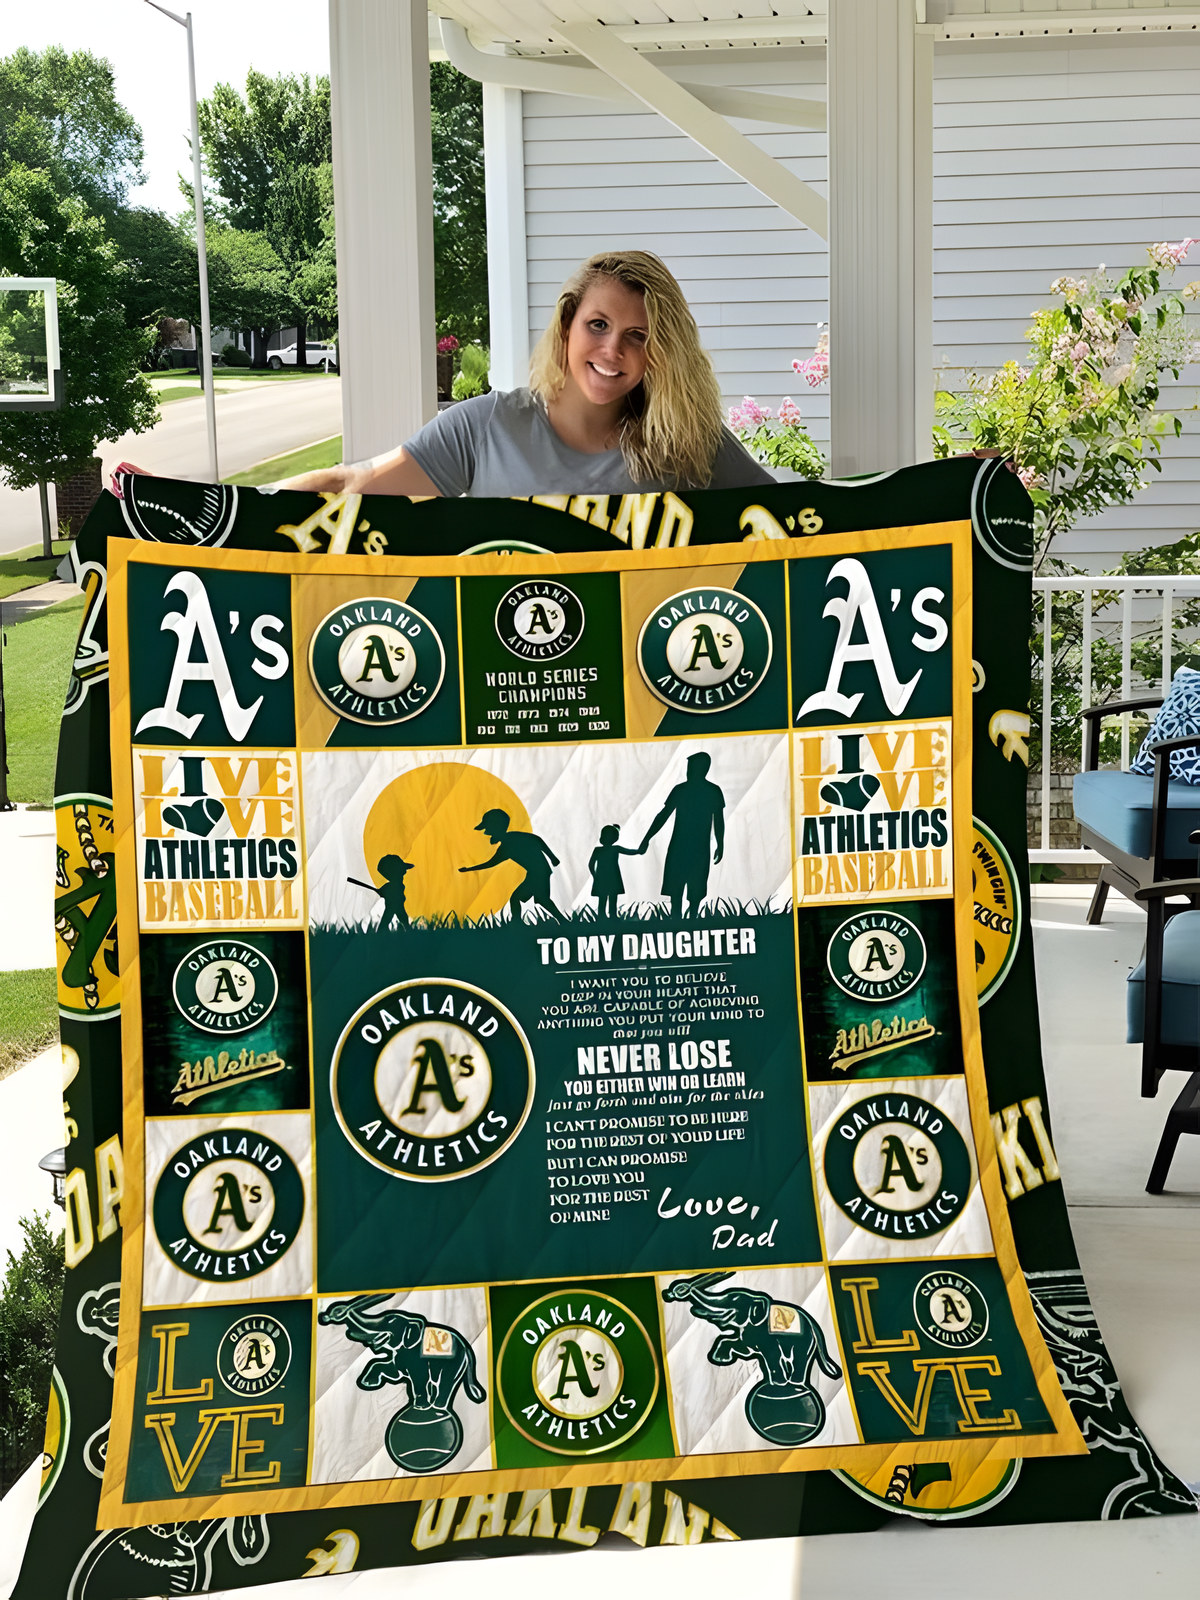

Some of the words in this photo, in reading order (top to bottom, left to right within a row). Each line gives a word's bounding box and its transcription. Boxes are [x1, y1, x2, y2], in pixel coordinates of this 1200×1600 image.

[508, 585, 569, 606] OAKLAND
[658, 596, 750, 629] OAKLAND
[329, 606, 421, 637] OAKLAND
[525, 603, 558, 635] A's
[134, 569, 291, 742] A's
[507, 633, 573, 656] ATHLETICS
[684, 624, 733, 673] A's
[796, 558, 949, 721] A's
[355, 635, 405, 683] A's
[543, 668, 598, 684] SERIES
[328, 682, 427, 716] ATHLETICS
[657, 668, 754, 705] ATHLETICS
[800, 726, 948, 776] LIVE
[139, 754, 293, 797] LIVE
[801, 808, 948, 855] ATHLETICS
[144, 838, 298, 879] ATHLETICS
[803, 849, 948, 896] BASEBALL
[144, 880, 298, 922] BASEBALL
[537, 937, 570, 965] TO
[577, 934, 615, 963] MY
[622, 928, 756, 961] DAUGHTER
[841, 918, 910, 942] OAKLAND
[188, 946, 260, 972] OAKLAND
[861, 937, 898, 972] A's
[208, 967, 247, 1003] A's
[622, 976, 648, 987] YOU
[655, 975, 671, 985] TO
[841, 969, 914, 995] ATHLETICS
[188, 1001, 264, 1028] ATHLETICS
[361, 993, 498, 1045] OAKLAND
[541, 1005, 569, 1016] YOU
[608, 1015, 635, 1027] YOU
[748, 1008, 765, 1019] TO
[577, 1043, 661, 1075] NEVER
[668, 1039, 732, 1070] LOSE
[400, 1037, 475, 1116] A's
[564, 1080, 593, 1096] YOU
[596, 1077, 644, 1094] EITHER
[648, 1075, 677, 1092] WIN
[703, 1071, 745, 1088] LEARN
[359, 1110, 508, 1167] ATHLETICS
[668, 1114, 690, 1126] TO
[715, 1128, 745, 1141] LIFE
[839, 1100, 943, 1140] OAKLAND
[174, 1136, 282, 1179] OAKLAND
[587, 1155, 618, 1168] CAN
[871, 1134, 929, 1197] A's
[548, 1176, 569, 1188] TO
[612, 1171, 645, 1184] YOU
[202, 1172, 262, 1236] A's
[573, 1209, 610, 1223] MINE
[657, 1187, 760, 1220] Love,
[844, 1190, 959, 1234] ATHLETICS
[169, 1229, 286, 1276] ATHLETICS
[712, 1219, 778, 1250] Dad
[522, 1303, 626, 1345] OAKLAND
[840, 1277, 921, 1354] L
[146, 1322, 214, 1406] L
[549, 1340, 606, 1401] A's
[856, 1355, 1023, 1436] VE
[521, 1394, 637, 1440] ATHLETICS
[144, 1403, 285, 1493] VE
[411, 1481, 742, 1552] OAKLAN
